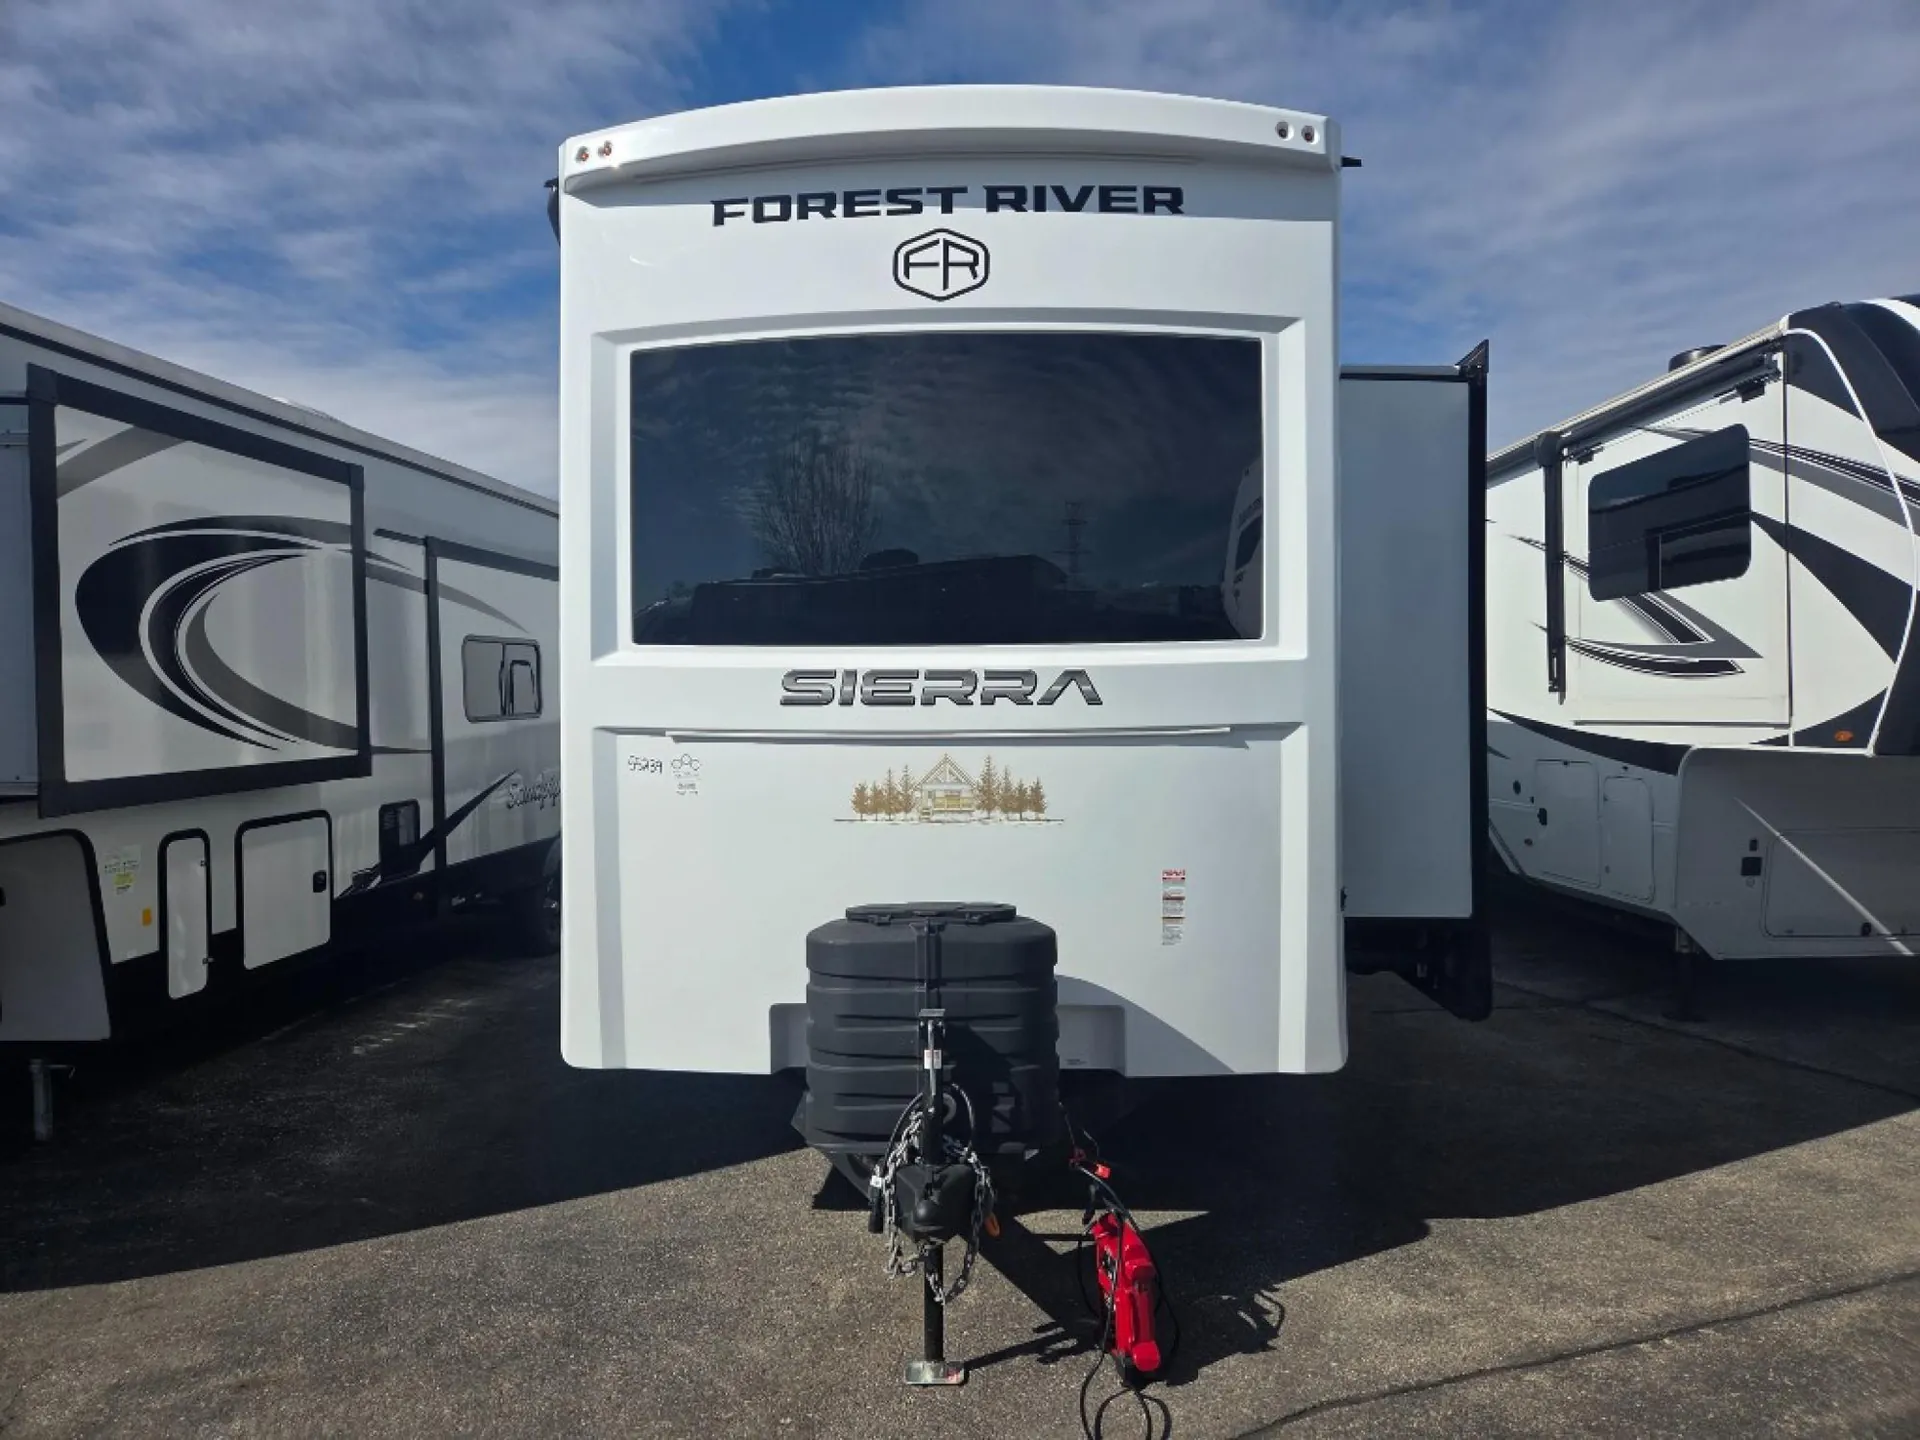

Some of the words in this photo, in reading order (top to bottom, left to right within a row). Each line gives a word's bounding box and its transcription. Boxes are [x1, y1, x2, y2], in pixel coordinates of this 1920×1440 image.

[710, 187, 968, 226] FOREST
[982, 184, 1184, 215] RIVER
[902, 236, 981, 293] FR
[780, 668, 1103, 706] SIERRA
